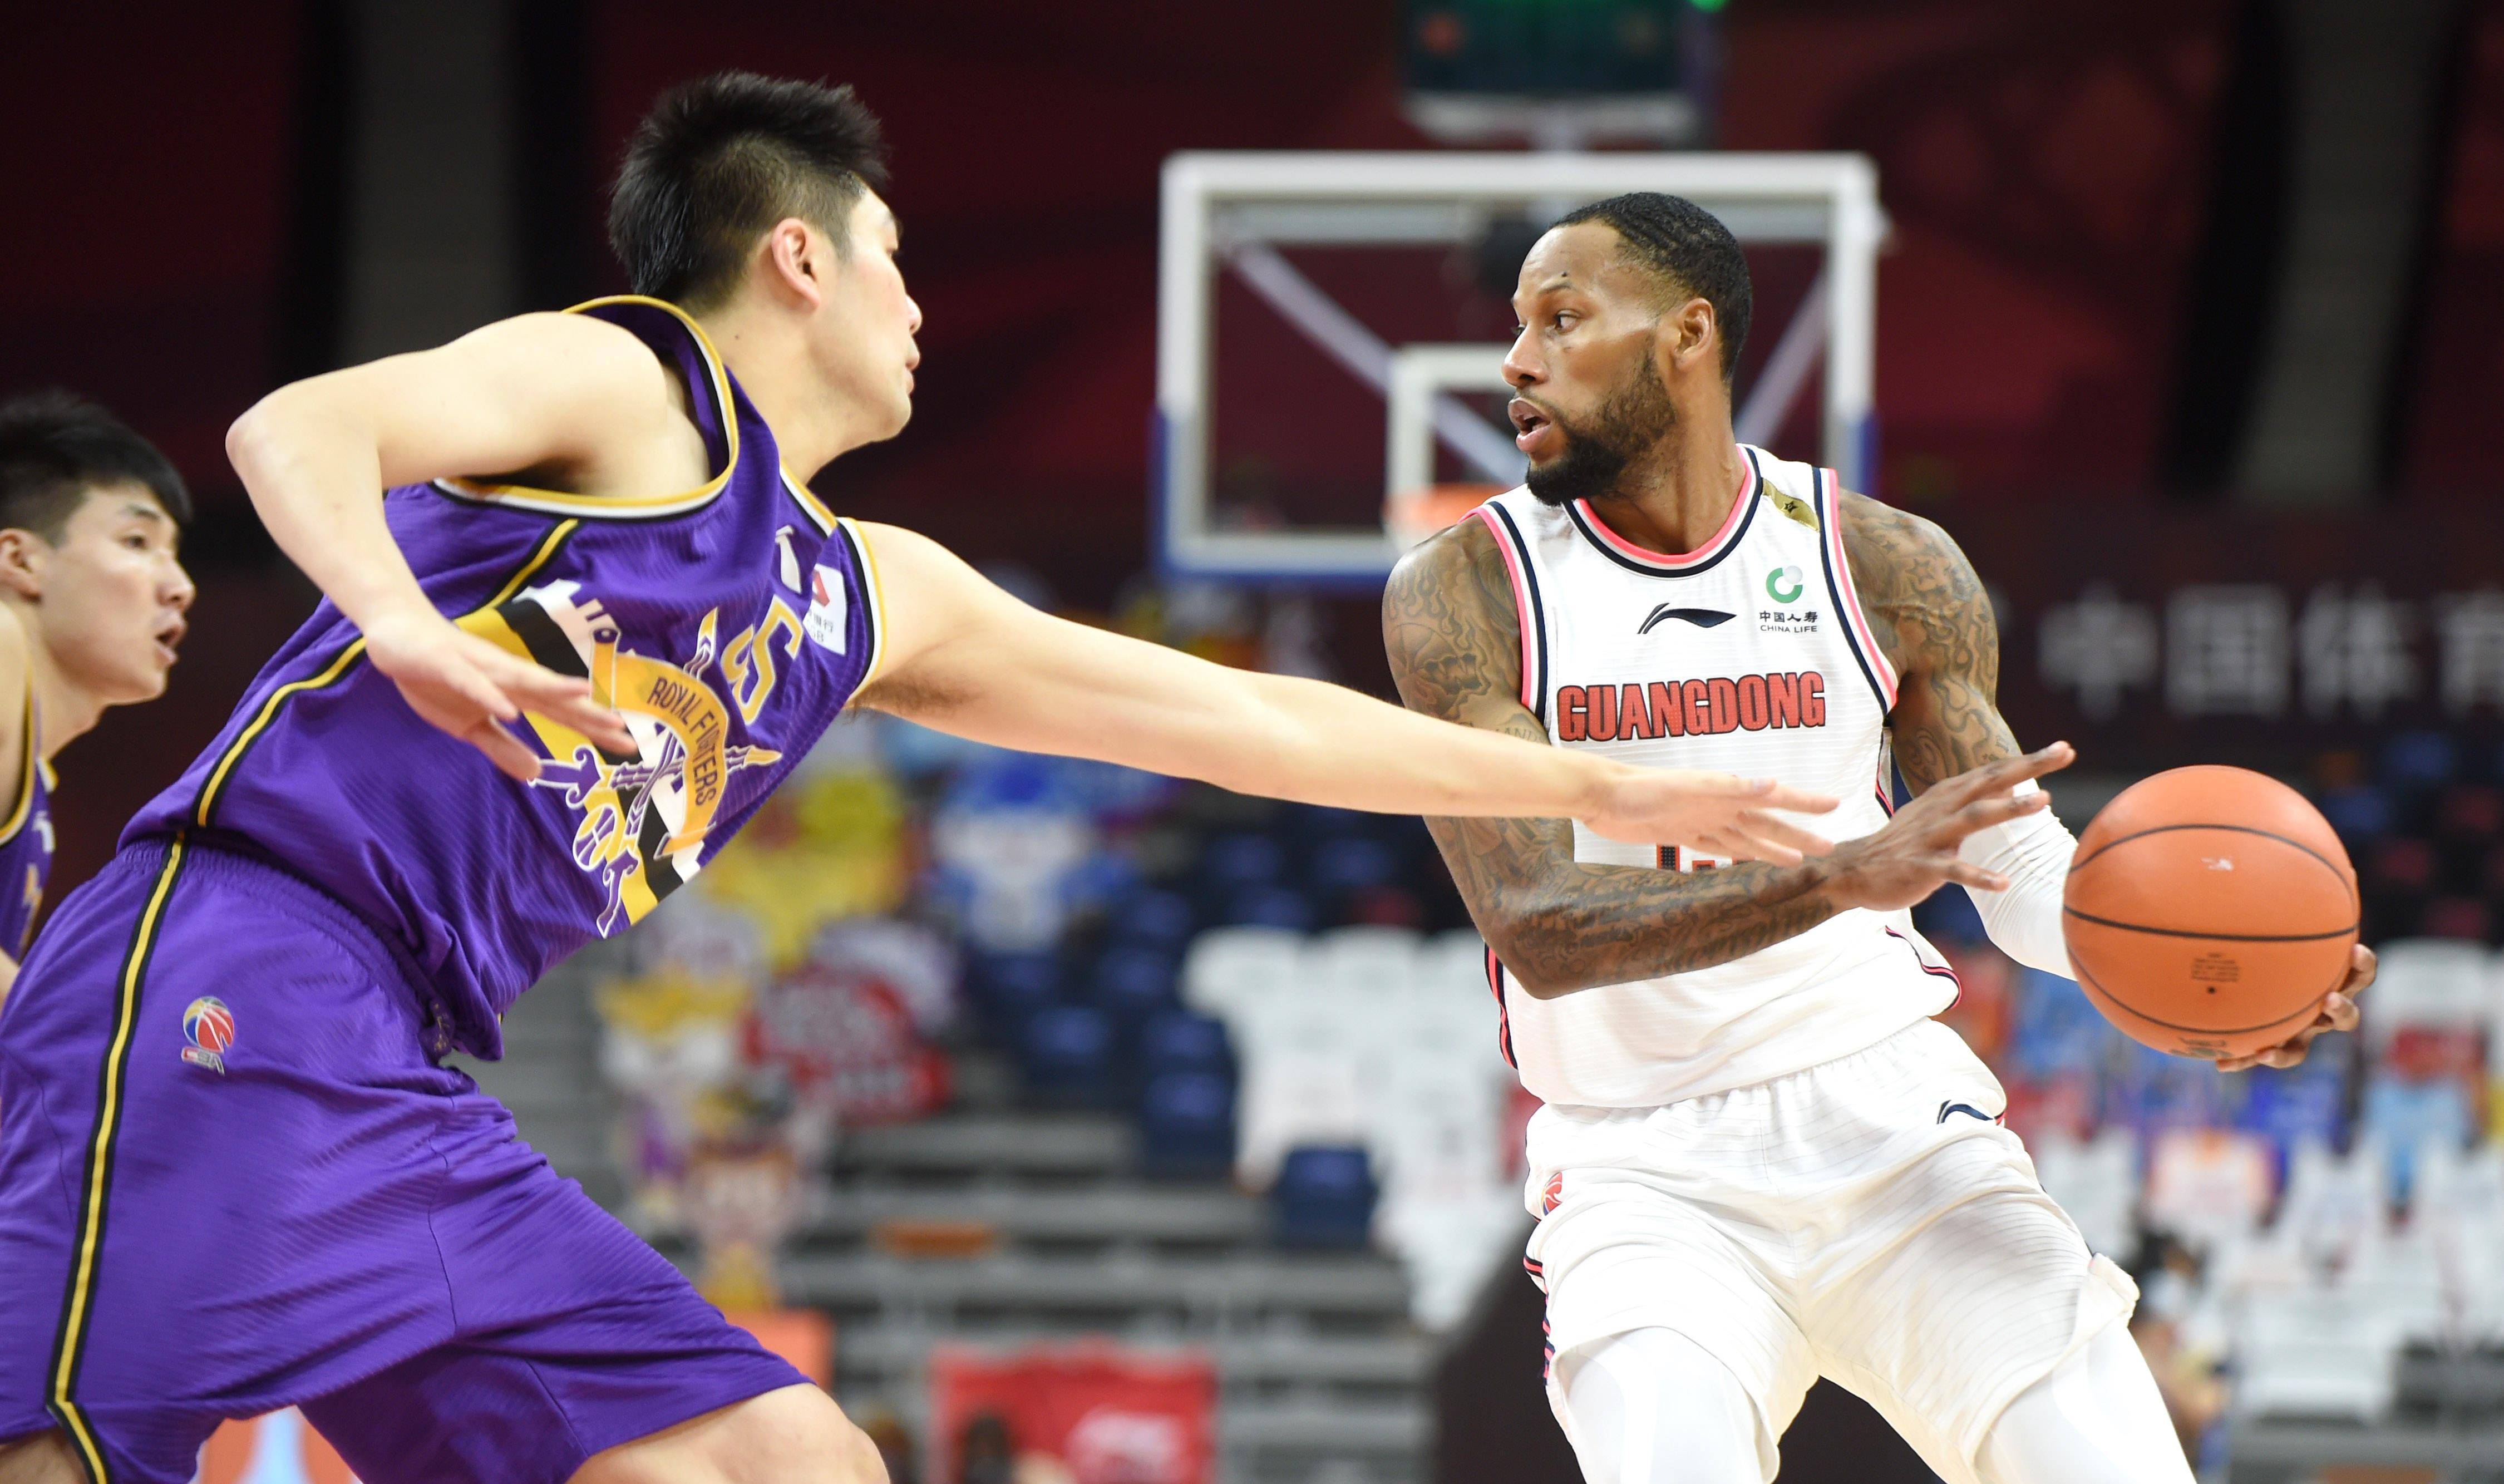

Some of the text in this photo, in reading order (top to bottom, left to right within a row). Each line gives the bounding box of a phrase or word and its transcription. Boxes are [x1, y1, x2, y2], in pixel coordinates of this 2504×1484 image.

[1759, 610, 1818, 623] 中国人寿
[647, 676, 720, 806] ROYAL FIGTERS
[1557, 671, 1825, 741] GUANGDONG
